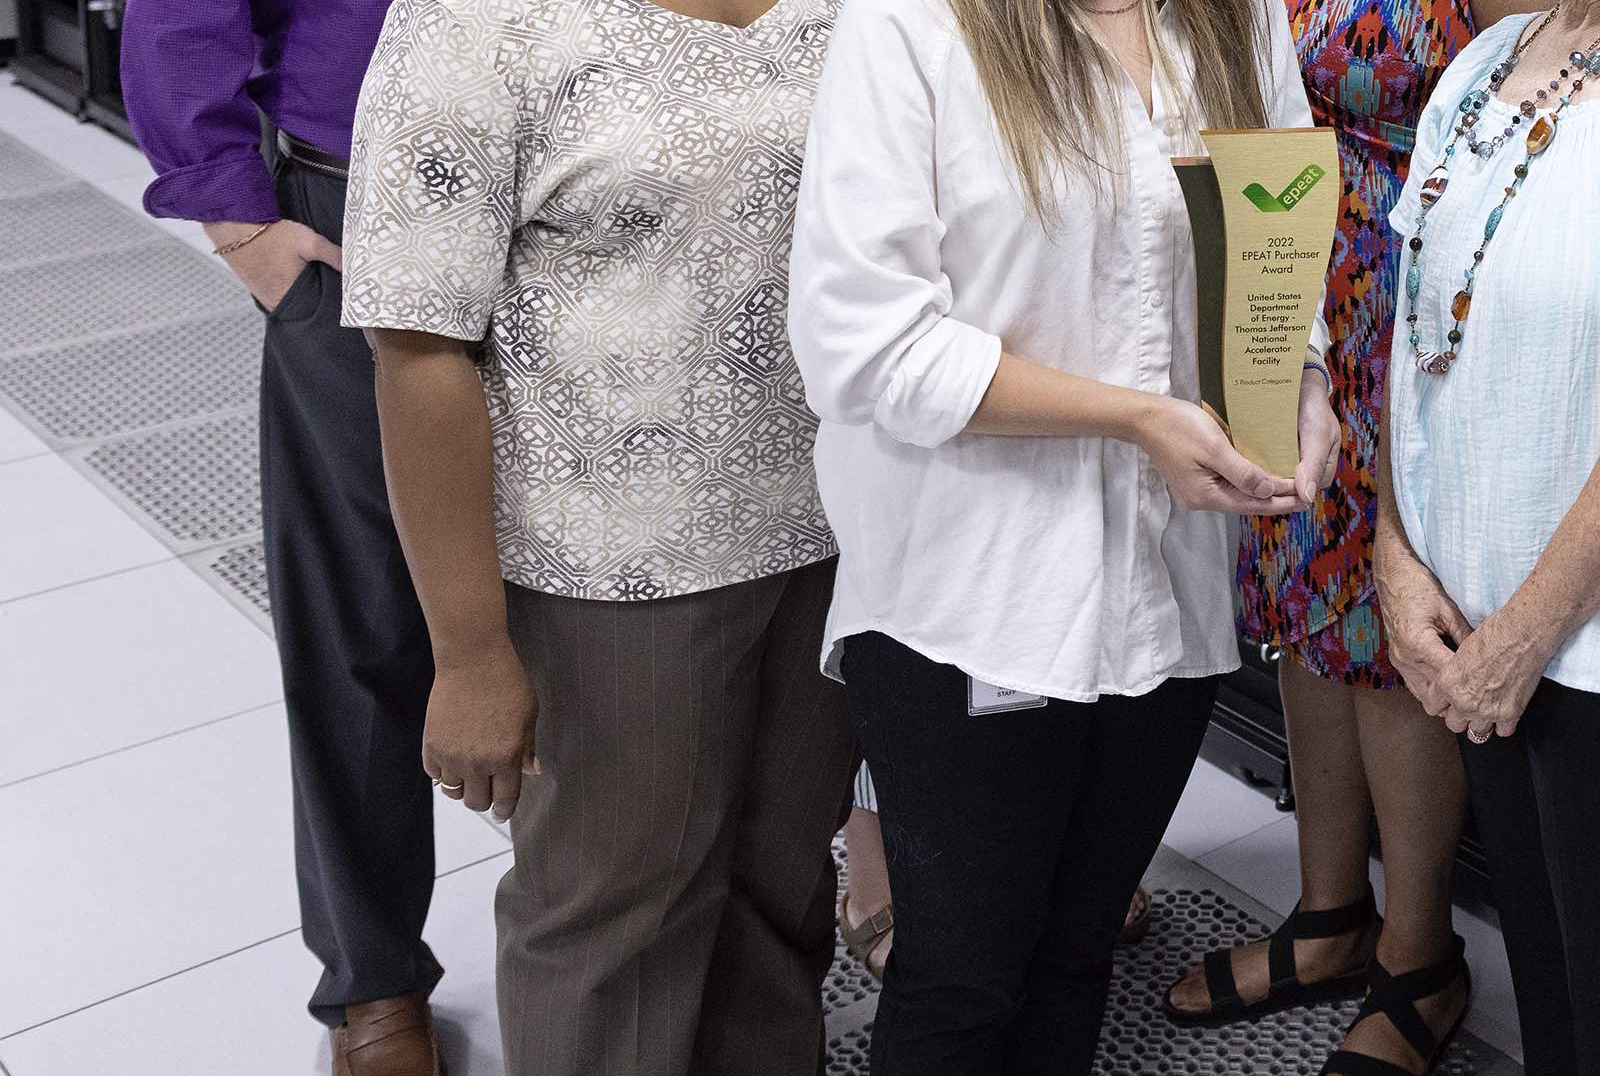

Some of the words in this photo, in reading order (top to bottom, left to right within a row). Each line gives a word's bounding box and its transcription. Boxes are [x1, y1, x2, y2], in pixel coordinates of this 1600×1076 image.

[1283, 168, 1319, 205] epeat
[1267, 237, 1294, 247] 2022
[1242, 251, 1272, 261] EPEAT
[1274, 249, 1320, 260] Purchaser
[1261, 264, 1293, 275] Award
[1247, 293, 1275, 302] United
[1277, 292, 1302, 300] States
[1250, 303, 1299, 313] Department
[1250, 314, 1260, 322] of
[1261, 314, 1290, 323] Energy
[1235, 325, 1267, 333] Thomas
[1269, 324, 1306, 333] Jefferson
[1251, 334, 1287, 343] National
[1245, 346, 1292, 354] Accelerator
[1252, 356, 1281, 366] Facility
[1240, 378, 1261, 386] Product
[1261, 378, 1292, 386] Categories
[997, 690, 1016, 698] STAFF
